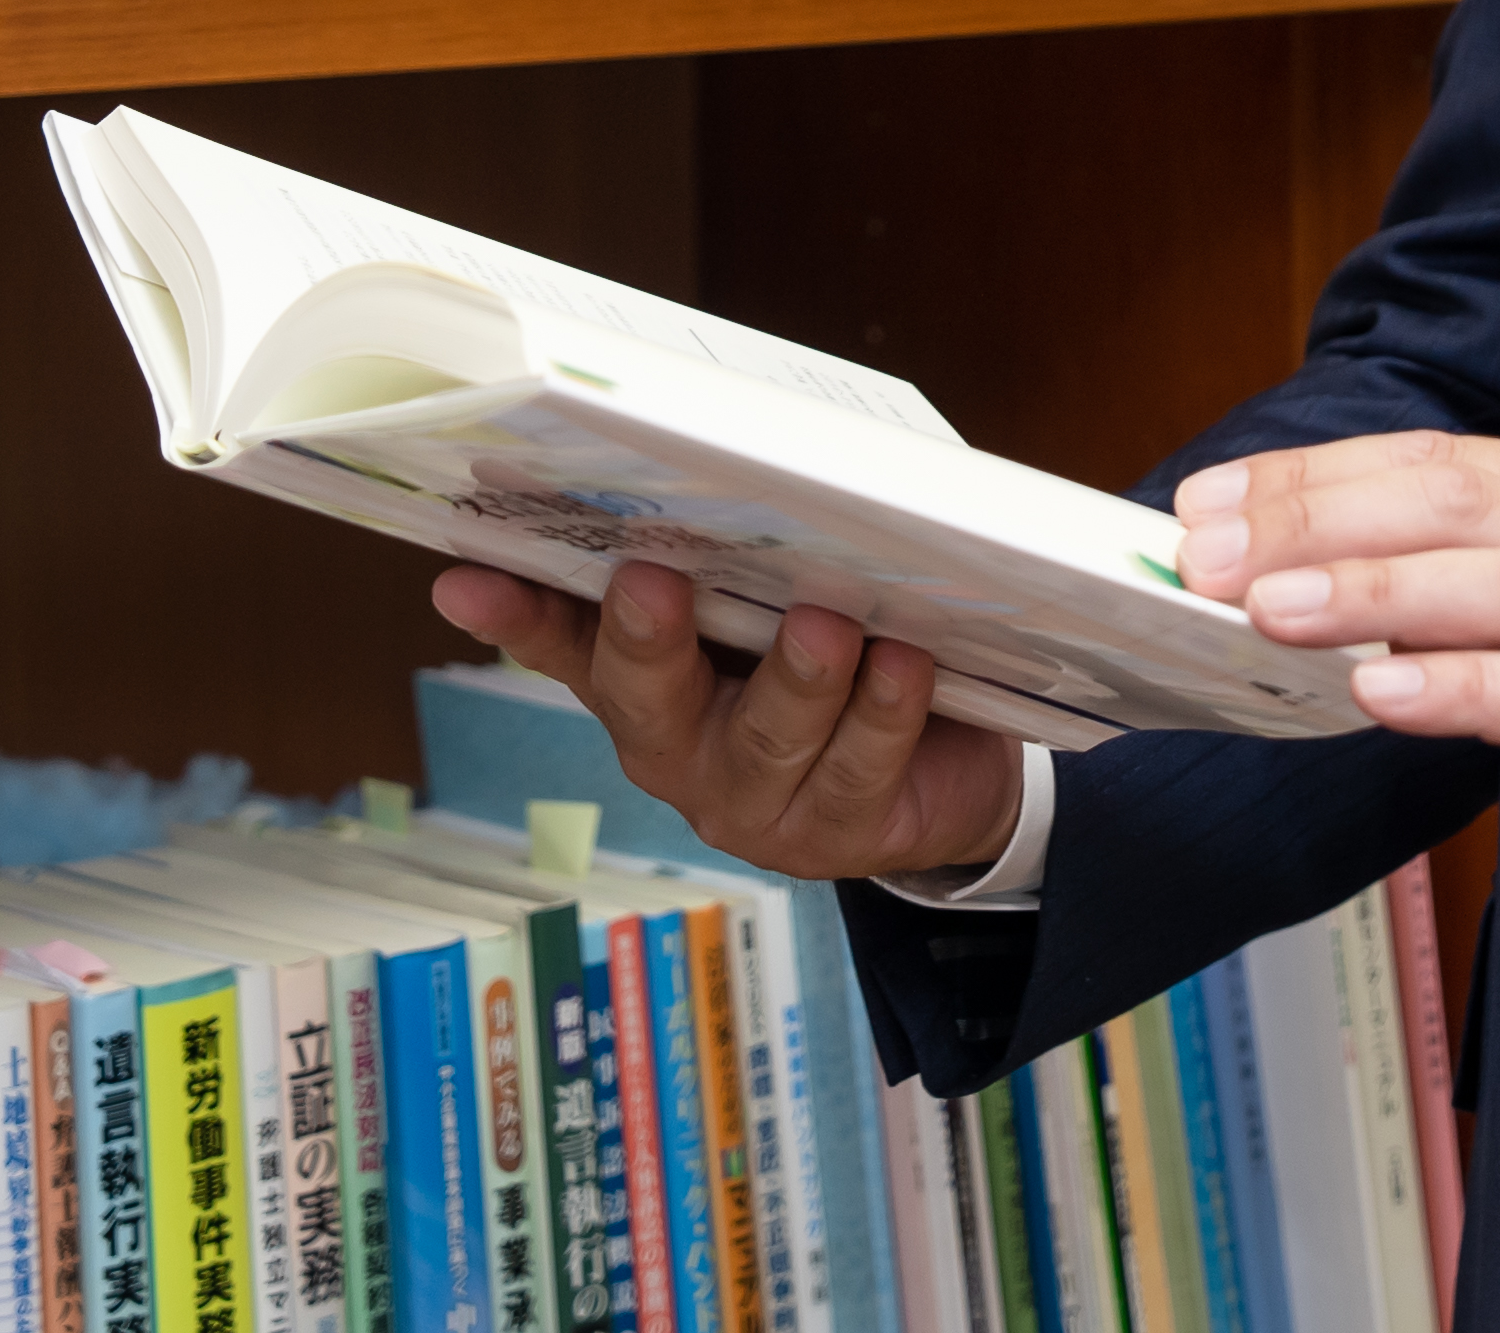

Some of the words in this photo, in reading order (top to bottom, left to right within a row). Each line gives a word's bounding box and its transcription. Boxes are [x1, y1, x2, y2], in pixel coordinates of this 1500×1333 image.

[287, 1019, 344, 1306] 立証の実務
